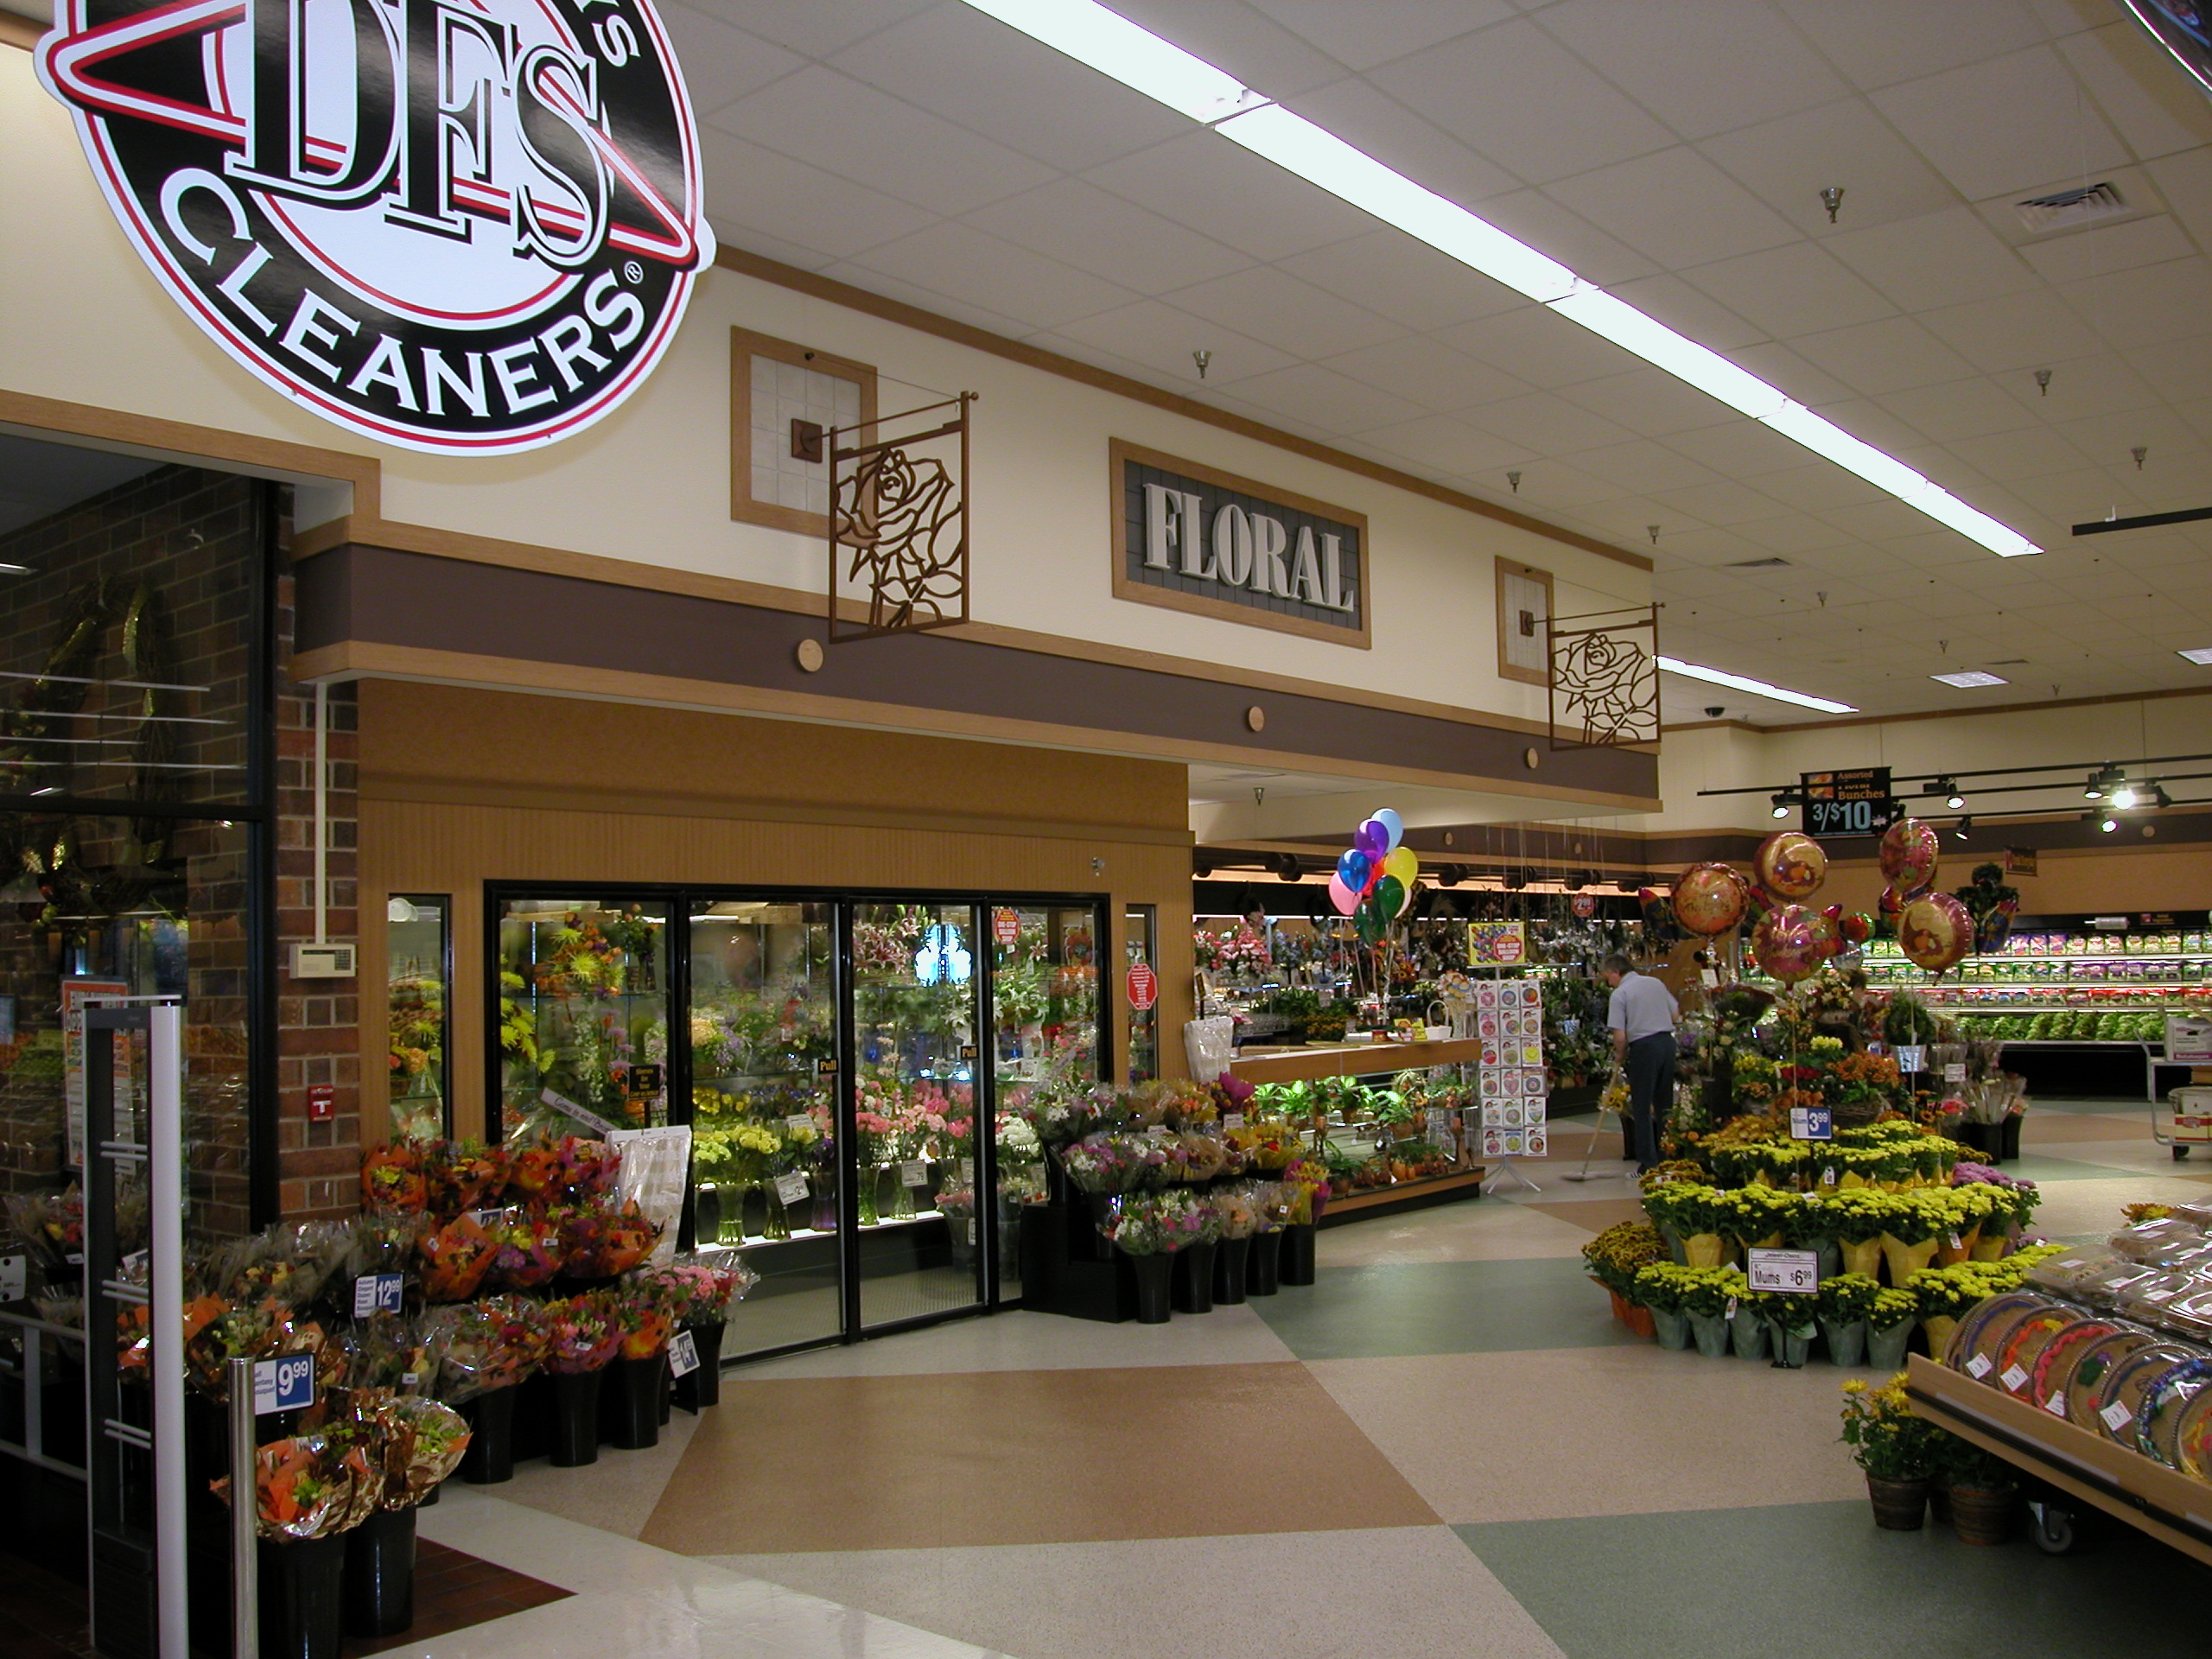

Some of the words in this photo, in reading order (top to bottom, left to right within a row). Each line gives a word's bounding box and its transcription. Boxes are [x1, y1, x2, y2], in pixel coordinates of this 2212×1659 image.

[223, 0, 608, 270] DFS
[160, 167, 646, 417] CLEANERS
[1142, 483, 1354, 613] FLORAL
[1838, 790, 1885, 800] Bunches
[962, 1047, 977, 1058] Pull
[820, 1059, 836, 1071] Pull
[1754, 1270, 1780, 1284] Mums
